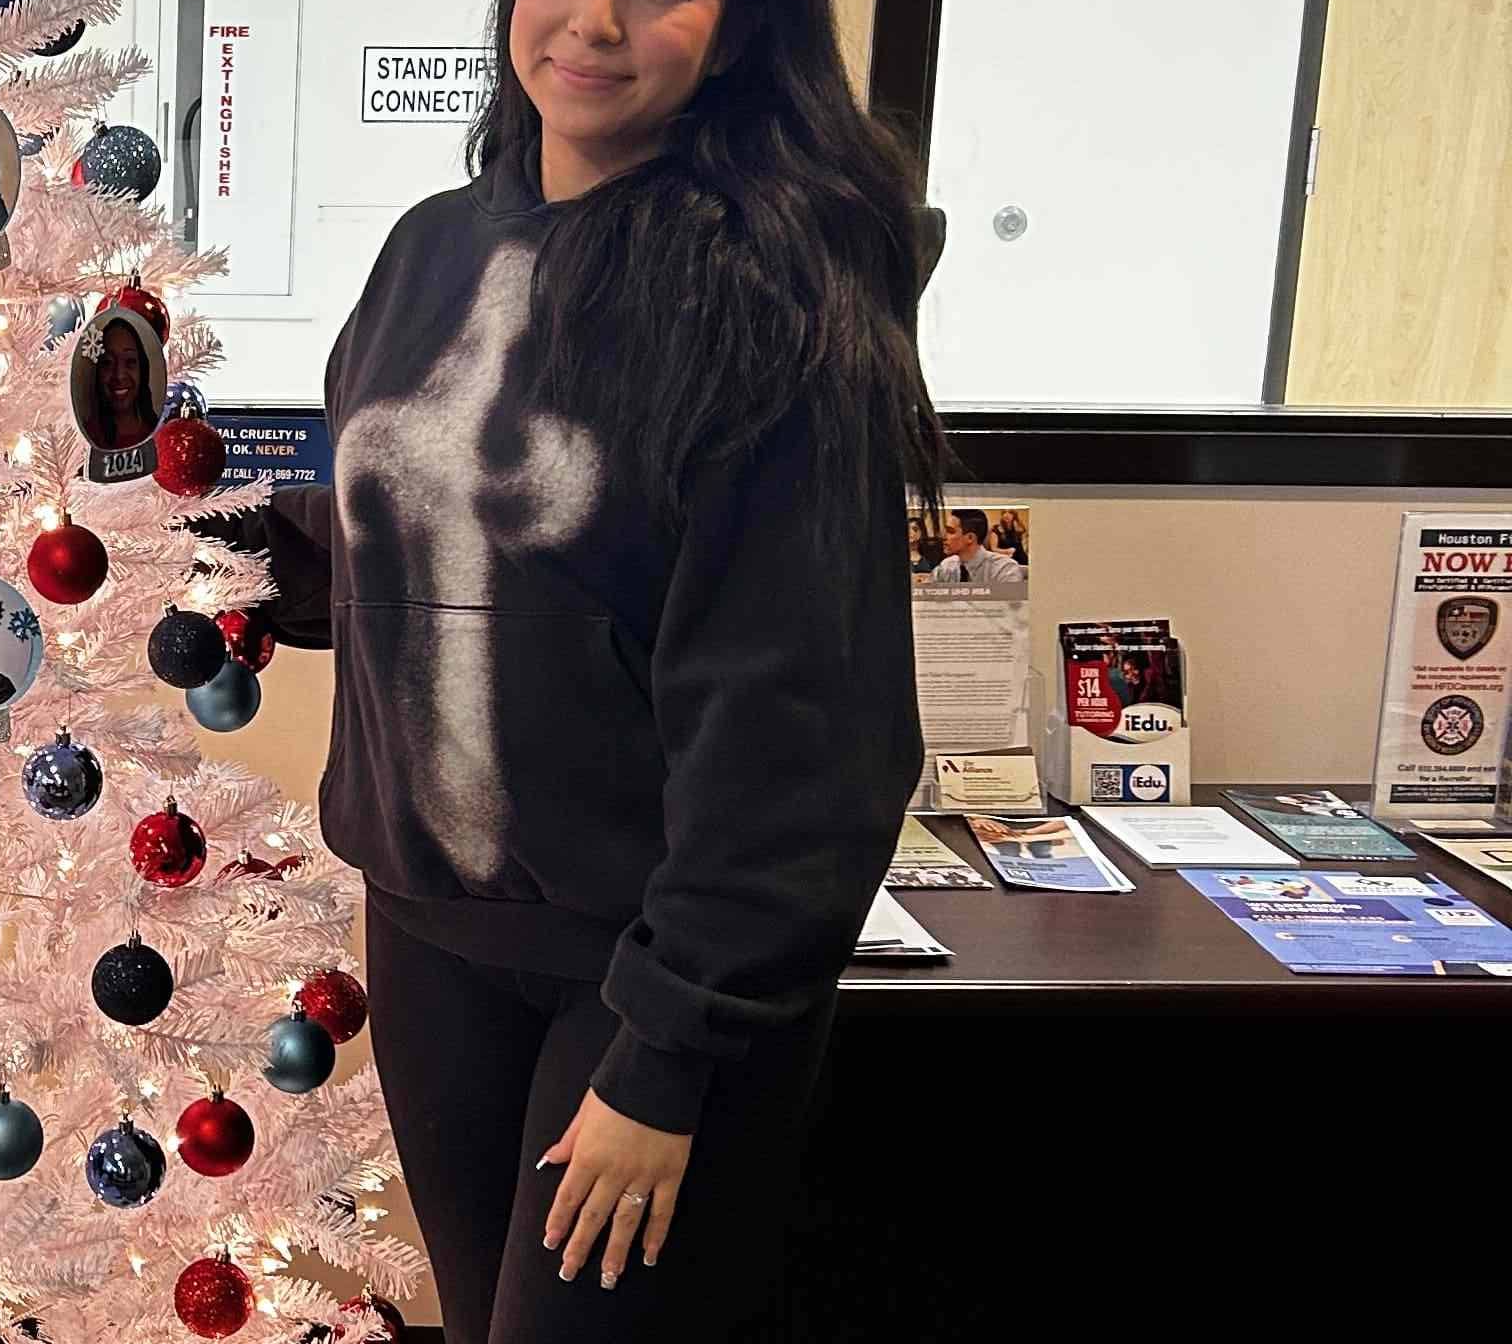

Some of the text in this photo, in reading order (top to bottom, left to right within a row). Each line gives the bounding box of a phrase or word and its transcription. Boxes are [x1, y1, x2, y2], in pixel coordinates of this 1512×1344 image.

[209, 26, 250, 37] FIRE
[377, 57, 447, 80] STAND
[218, 44, 234, 197] EXTINGUISHER
[240, 429, 293, 440] CRUELTY
[295, 430, 307, 441] IS
[232, 444, 253, 455] OK.
[255, 445, 299, 456] NEVER.
[103, 449, 143, 476] 2024
[233, 468, 253, 480] CALL
[1438, 533, 1493, 544] Houston
[1421, 552, 1497, 573] NOW
[1077, 678, 1101, 697] $14
[1125, 713, 1174, 732] iEdu.
